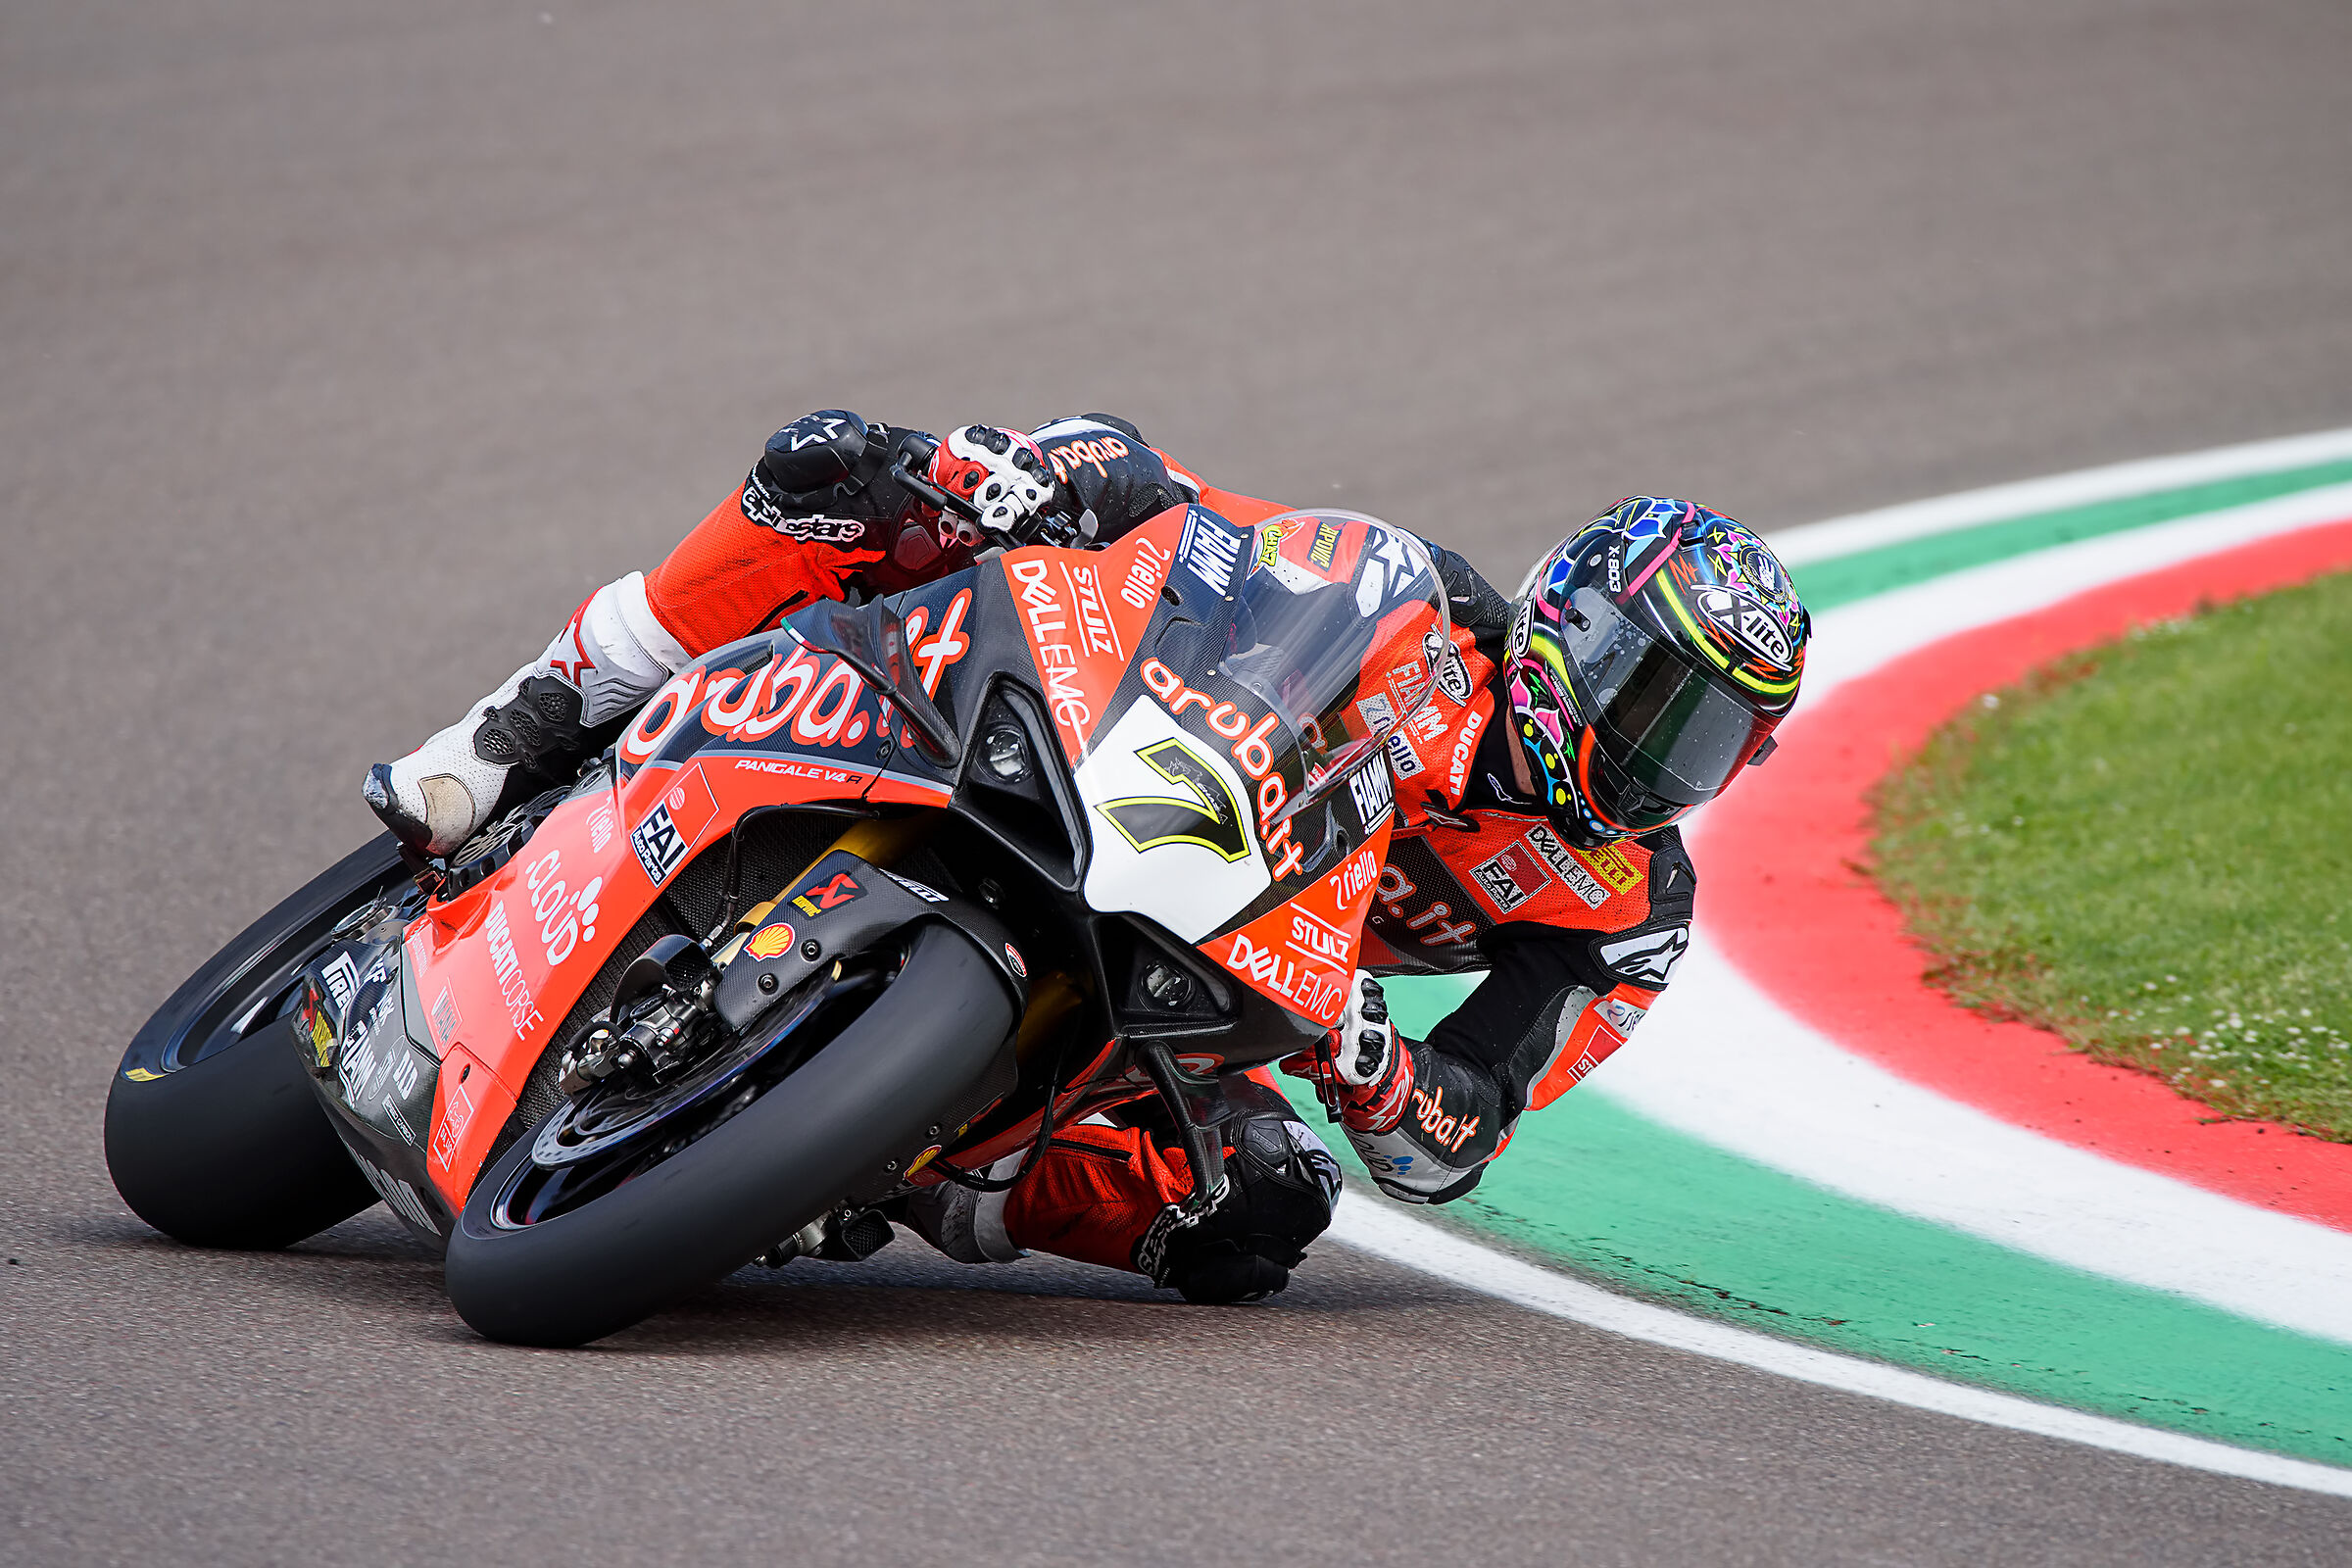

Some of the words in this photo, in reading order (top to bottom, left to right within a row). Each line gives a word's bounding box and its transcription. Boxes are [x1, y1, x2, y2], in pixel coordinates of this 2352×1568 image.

[1187, 515, 1242, 596] FIAMM
[1608, 545, 1622, 593] X-803
[1074, 566, 1113, 654] STULZ
[735, 759, 823, 780] PANIGALE
[1141, 658, 1303, 881] aruba.it
[1348, 750, 1393, 824] FIAMM
[1449, 710, 1483, 795] DUCATI
[643, 803, 685, 869] FAI
[1095, 737, 1250, 863] 7
[1483, 861, 1525, 905] FAI
[1291, 916, 1349, 963] STULZ
